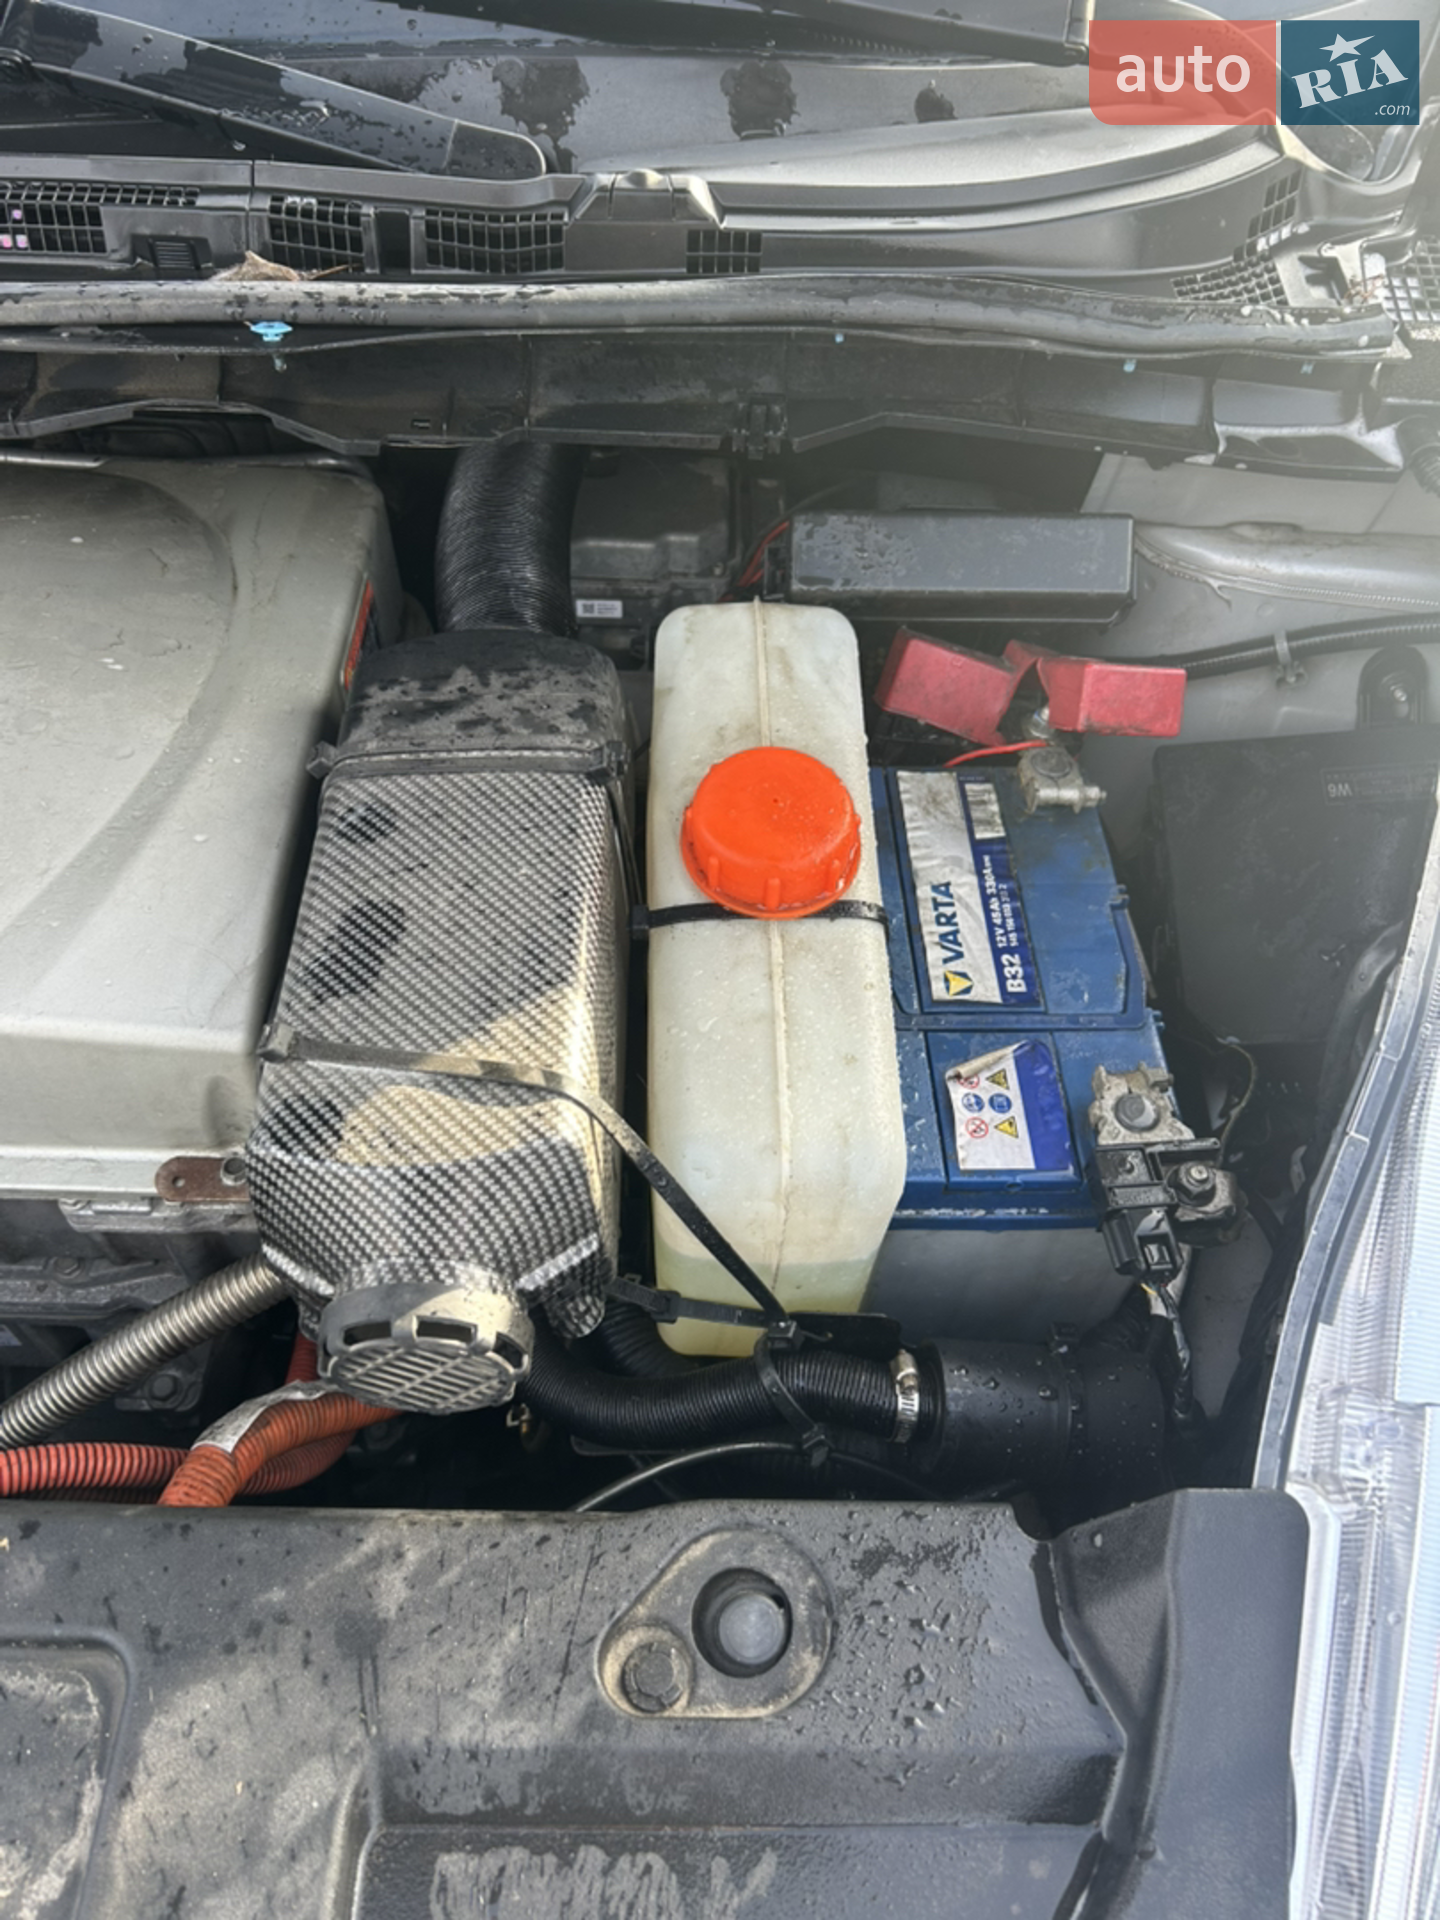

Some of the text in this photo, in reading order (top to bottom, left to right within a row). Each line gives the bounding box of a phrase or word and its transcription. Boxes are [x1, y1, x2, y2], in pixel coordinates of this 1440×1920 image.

[931, 881, 965, 965] VARTA
[994, 926, 1007, 948] 12V
[1001, 953, 1027, 993] B32
